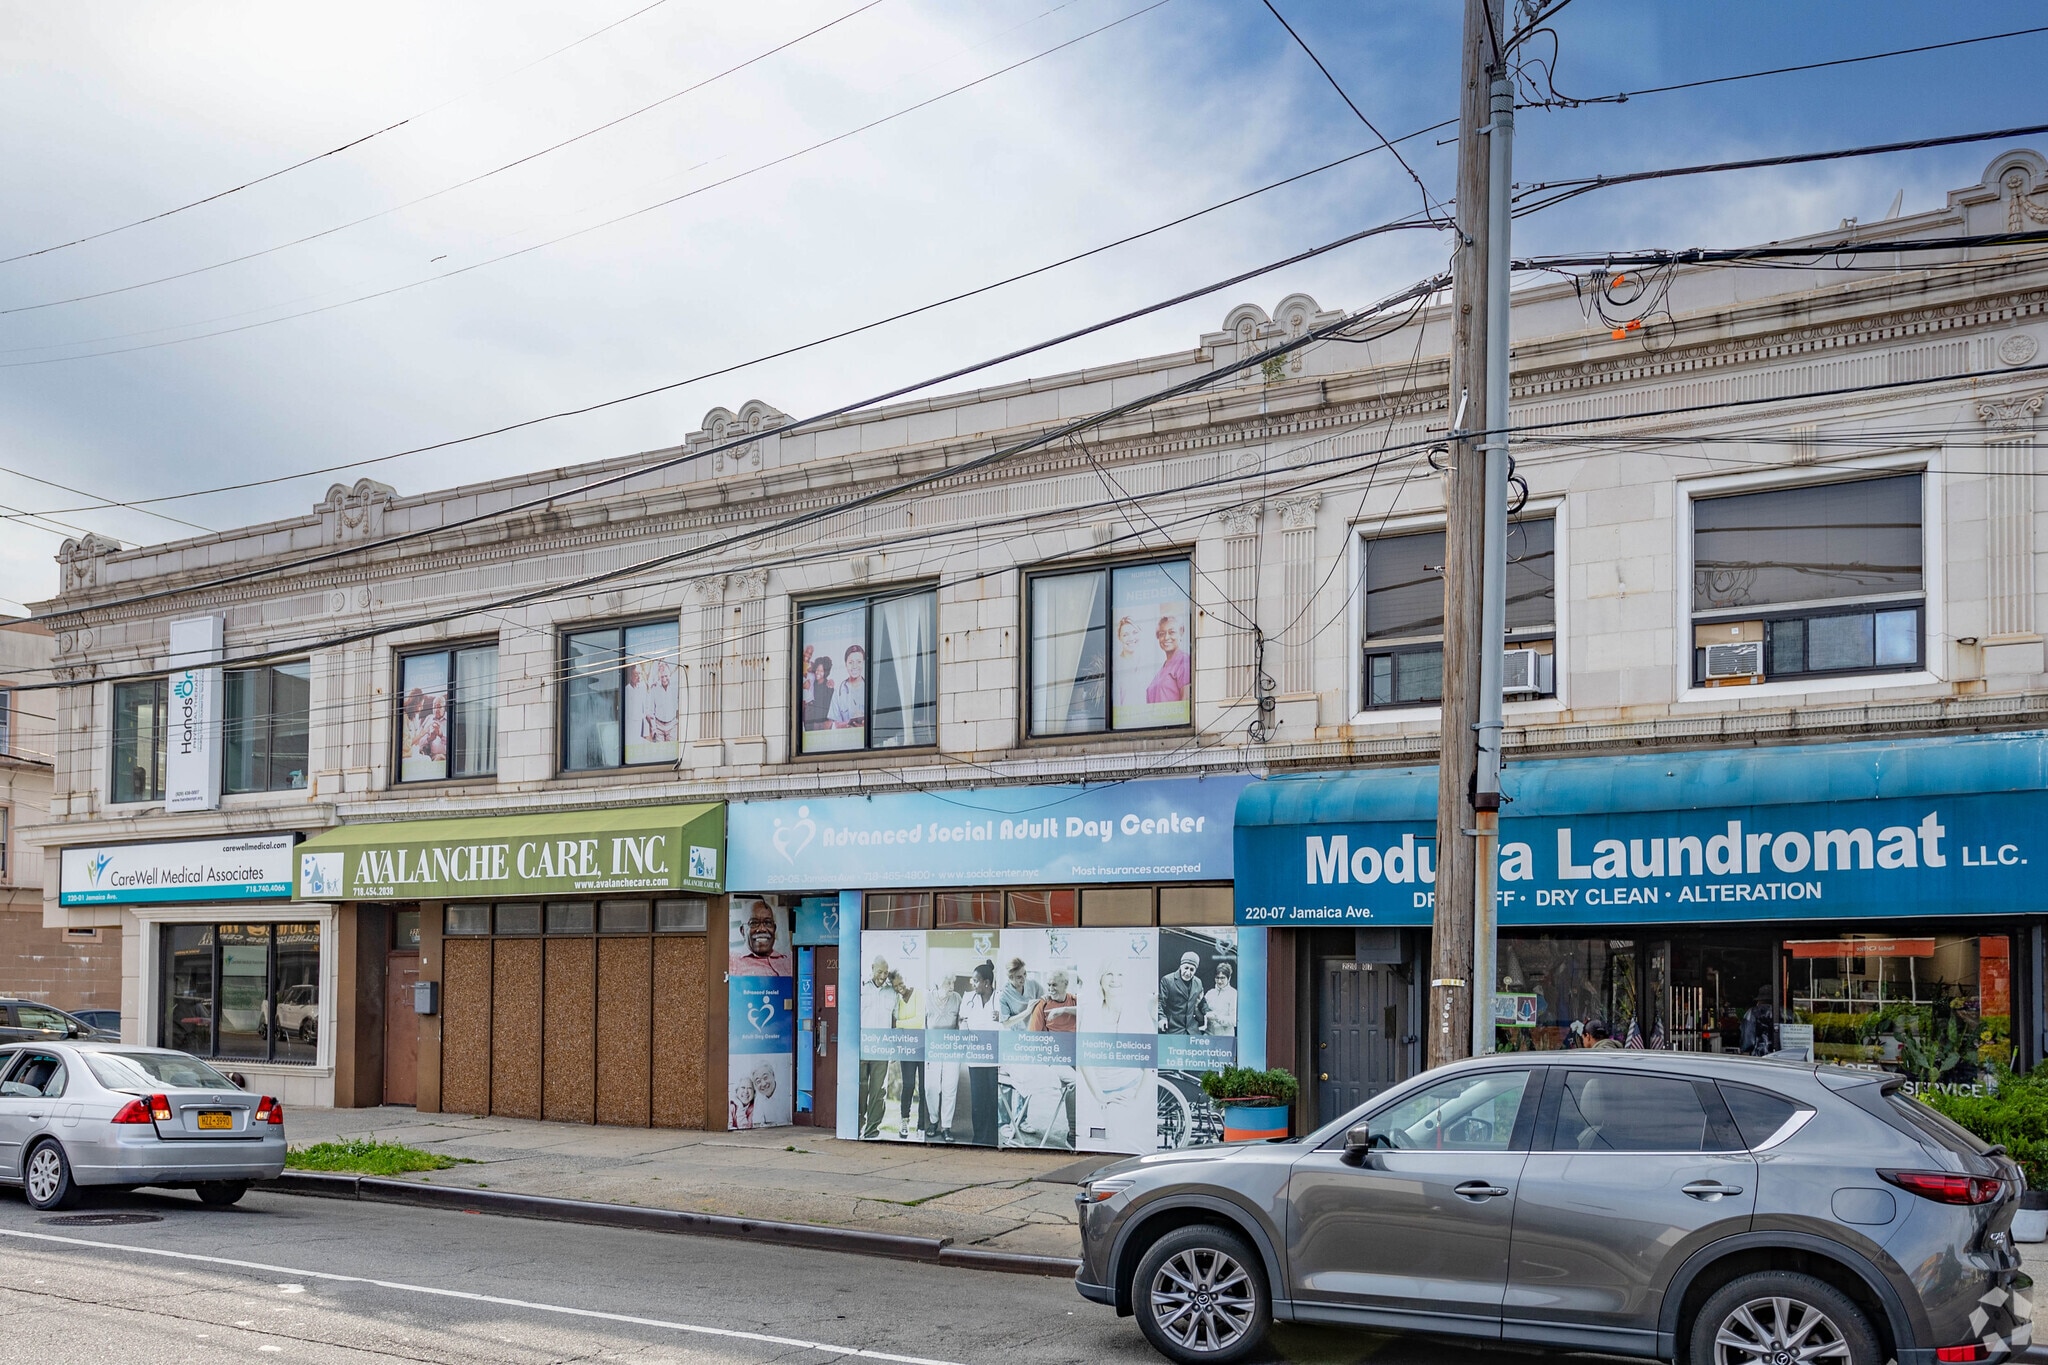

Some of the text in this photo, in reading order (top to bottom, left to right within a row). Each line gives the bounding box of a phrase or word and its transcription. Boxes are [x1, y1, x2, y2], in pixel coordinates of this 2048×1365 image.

[1126, 586, 1176, 600] NEEDED
[823, 812, 1205, 847] Advanced Social Adult Day Center
[222, 842, 286, 852] carewellmedical.com
[1557, 810, 1946, 879] Laundromat
[1962, 844, 2028, 866] LLC.
[353, 835, 669, 884] AVALANCHE CARE, INC.
[1072, 863, 1200, 876] Most insurances accepted
[110, 865, 264, 886] CareWell Medical Associates
[801, 874, 839, 883] Jamaica
[864, 870, 930, 881] 718-465-4800
[939, 869, 1039, 880] www.socialcenter.nyc
[245, 884, 286, 893] 718.740.4066
[574, 878, 668, 889] www.avalanchecare.com
[353, 886, 394, 896] 718.454.2038
[1537, 889, 1579, 906] DRY
[1585, 887, 1658, 905] CLEAN
[1678, 882, 1822, 903] ALTERATION
[1245, 905, 1374, 919] 220-07 Jamaica Ave.
[862, 1034, 918, 1043] Daily Activities
[944, 1034, 960, 1042] Help
[1019, 1034, 1056, 1045] Massage,
[1190, 1037, 1210, 1045] Free
[871, 1046, 895, 1055] Group
[897, 1046, 916, 1054] Trips
[953, 1042, 985, 1050] Services
[1014, 1045, 1052, 1054] Grooming
[1116, 1041, 1152, 1050] Delicious
[928, 1051, 994, 1060] Computer Classes
[1083, 1051, 1107, 1060] Meals
[1116, 1052, 1150, 1061] Exercise
[1168, 1047, 1232, 1057] Transportation
[1002, 1053, 1072, 1063] Laundry Services
